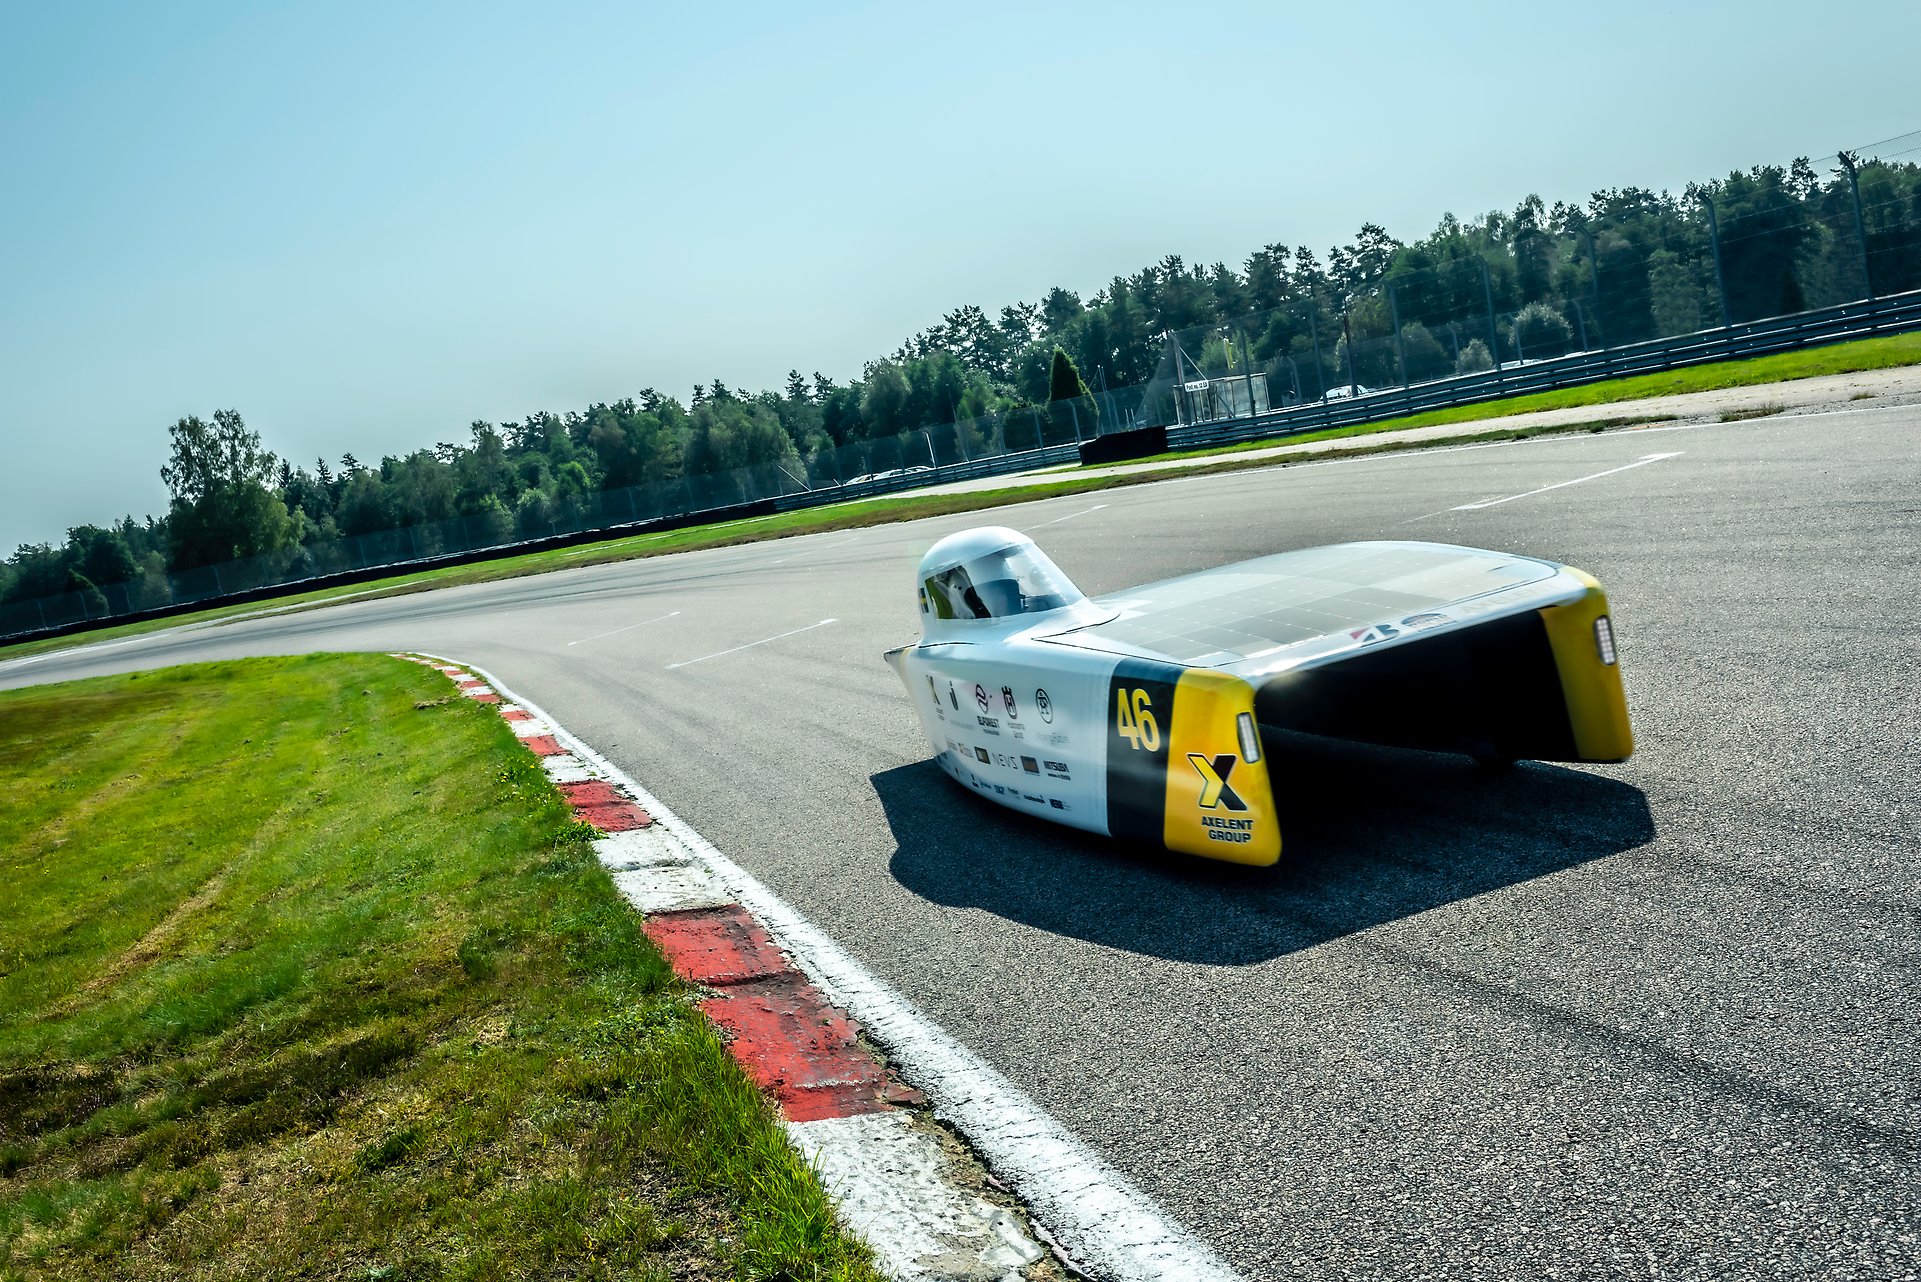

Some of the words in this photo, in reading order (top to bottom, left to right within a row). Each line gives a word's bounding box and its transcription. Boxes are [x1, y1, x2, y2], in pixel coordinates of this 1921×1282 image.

[1117, 688, 1161, 752] 46
[992, 752, 1018, 770] NEVS
[1201, 815, 1254, 830] AXELENT
[1208, 829, 1252, 843] GROUP
